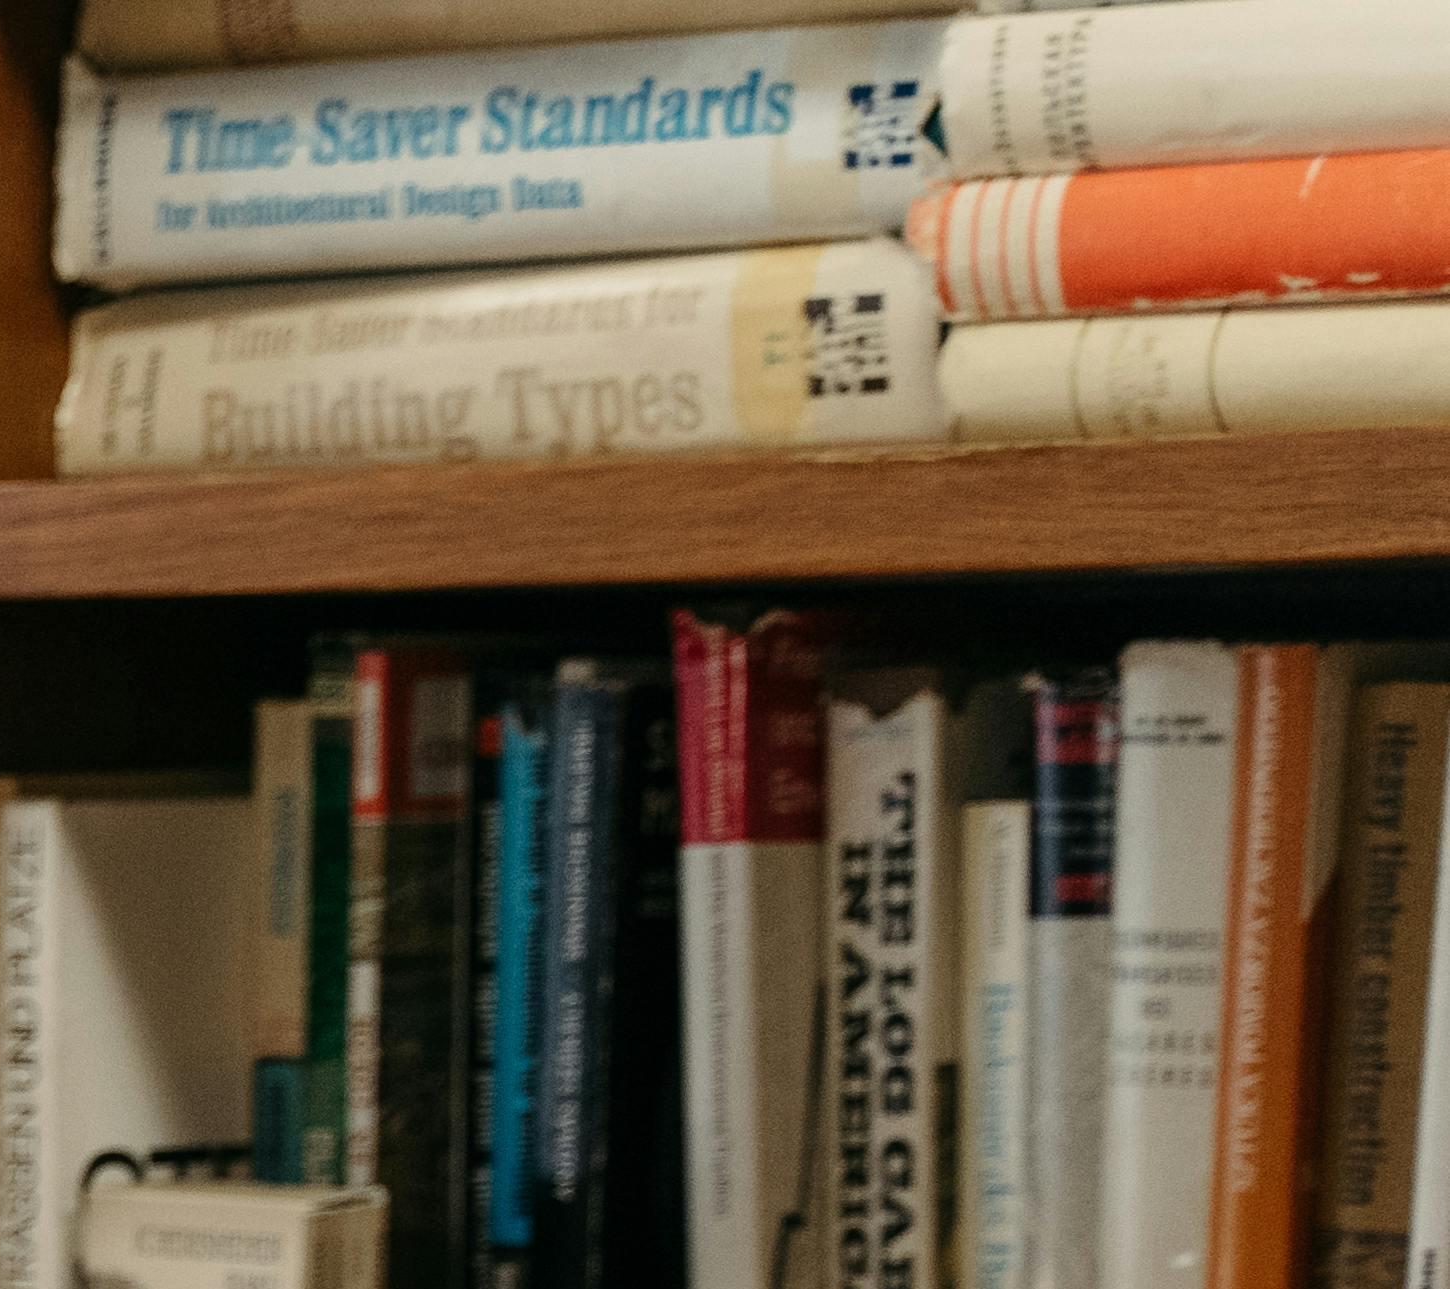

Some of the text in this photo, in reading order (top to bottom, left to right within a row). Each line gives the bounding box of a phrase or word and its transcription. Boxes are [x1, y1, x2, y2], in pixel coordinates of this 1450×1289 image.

[479, 68, 796, 155] Standards
[399, 181, 501, 224] Design
[510, 174, 584, 211] Data
[201, 376, 480, 466] Building
[493, 363, 706, 462] Types
[841, 842, 873, 925] IN
[879, 770, 920, 946] THE
[1340, 721, 1417, 1209] Heavy timber construction
[877, 965, 916, 1117] LOG
